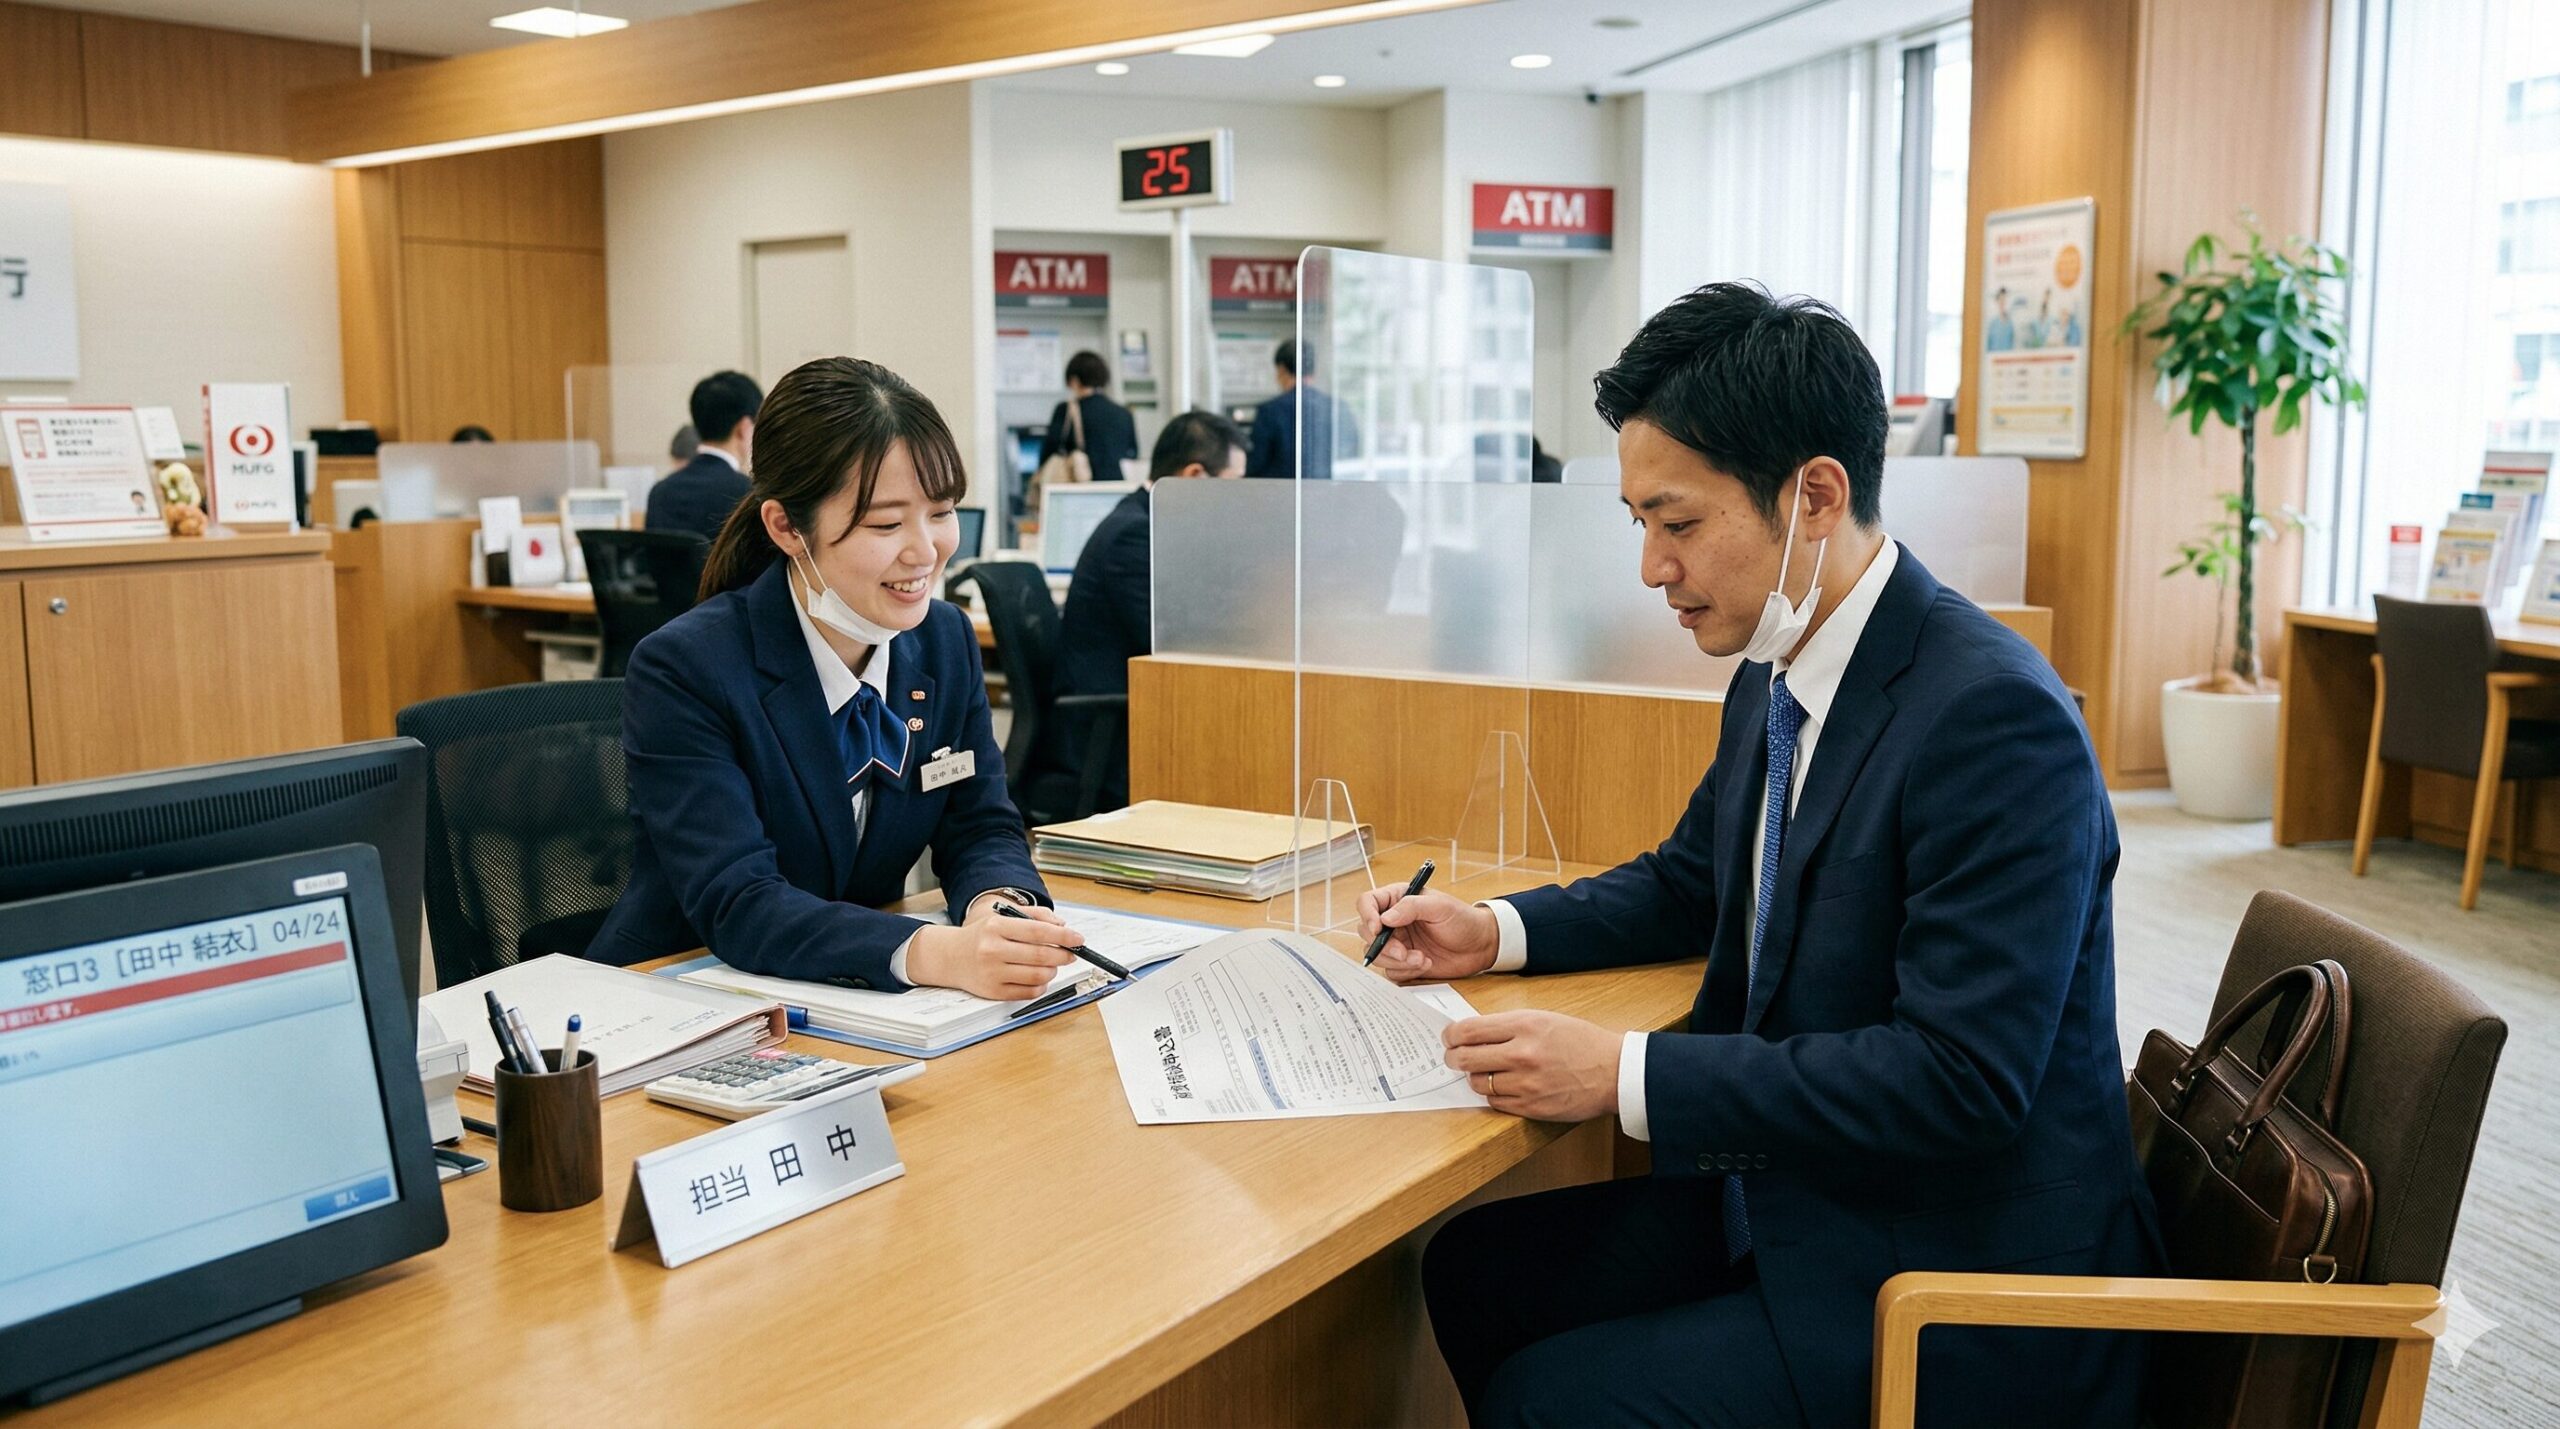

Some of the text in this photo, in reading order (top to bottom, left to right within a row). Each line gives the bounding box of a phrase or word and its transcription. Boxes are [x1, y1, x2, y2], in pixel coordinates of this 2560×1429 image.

[1142, 147, 1192, 196] 25
[1500, 190, 1586, 228] ATM
[1009, 257, 1088, 290] ATM
[1230, 263, 1297, 294] ATM
[232, 463, 275, 475] MUFG
[23, 958, 100, 995] 窓口3
[273, 910, 341, 943] 04/24
[689, 1164, 750, 1214] 担当
